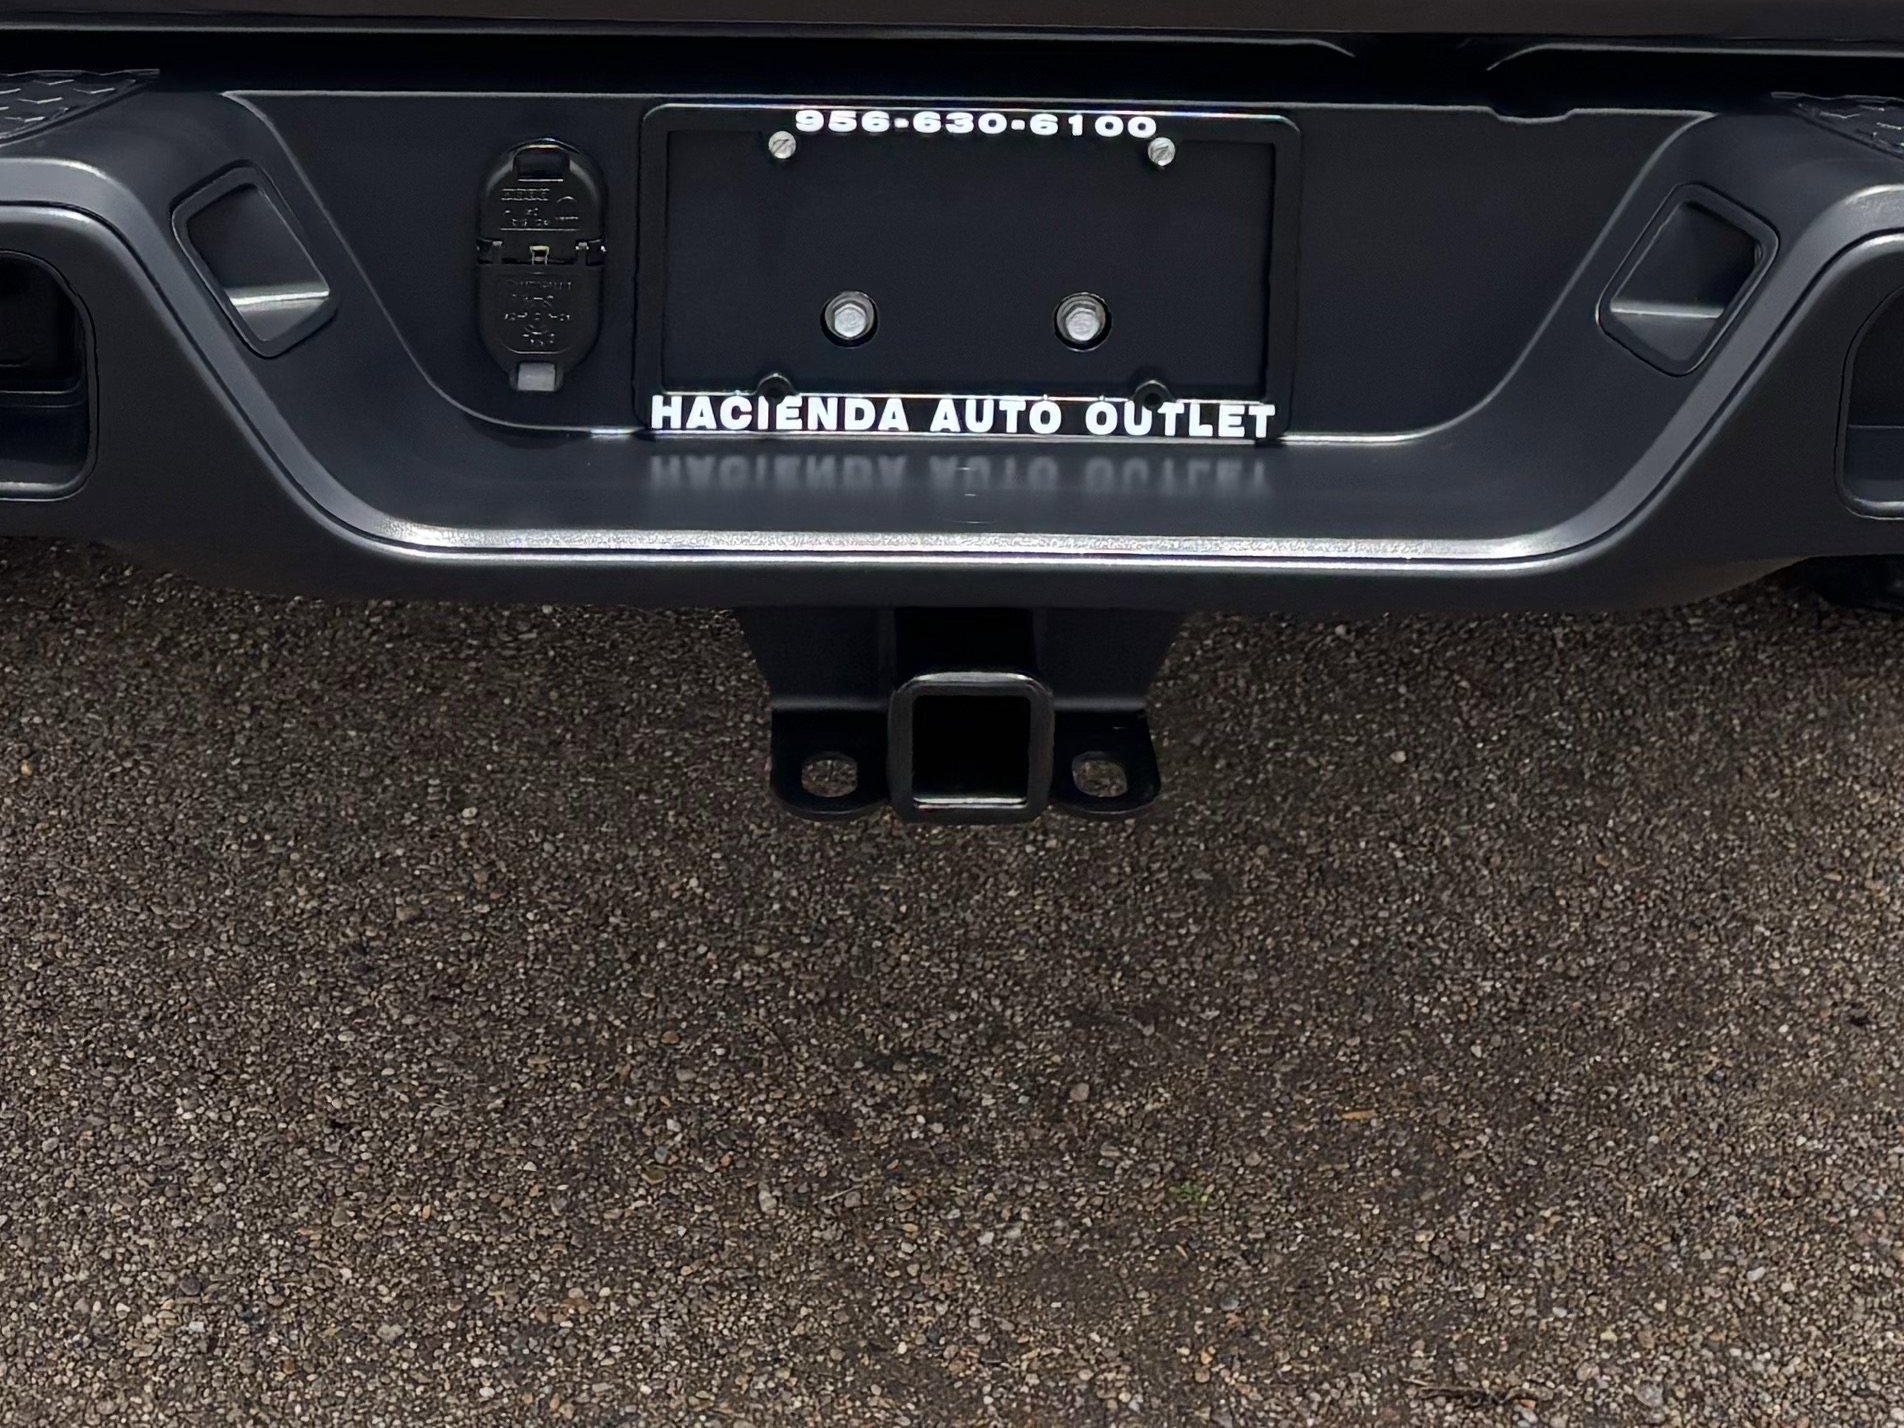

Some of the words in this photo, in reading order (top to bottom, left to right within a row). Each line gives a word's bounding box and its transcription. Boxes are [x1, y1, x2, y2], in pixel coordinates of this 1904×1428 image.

[795, 109, 1157, 138] 956-630-6100
[650, 394, 911, 432] HACIENDA
[929, 396, 1063, 435] AUTO
[1085, 400, 1277, 439] OUTLET
